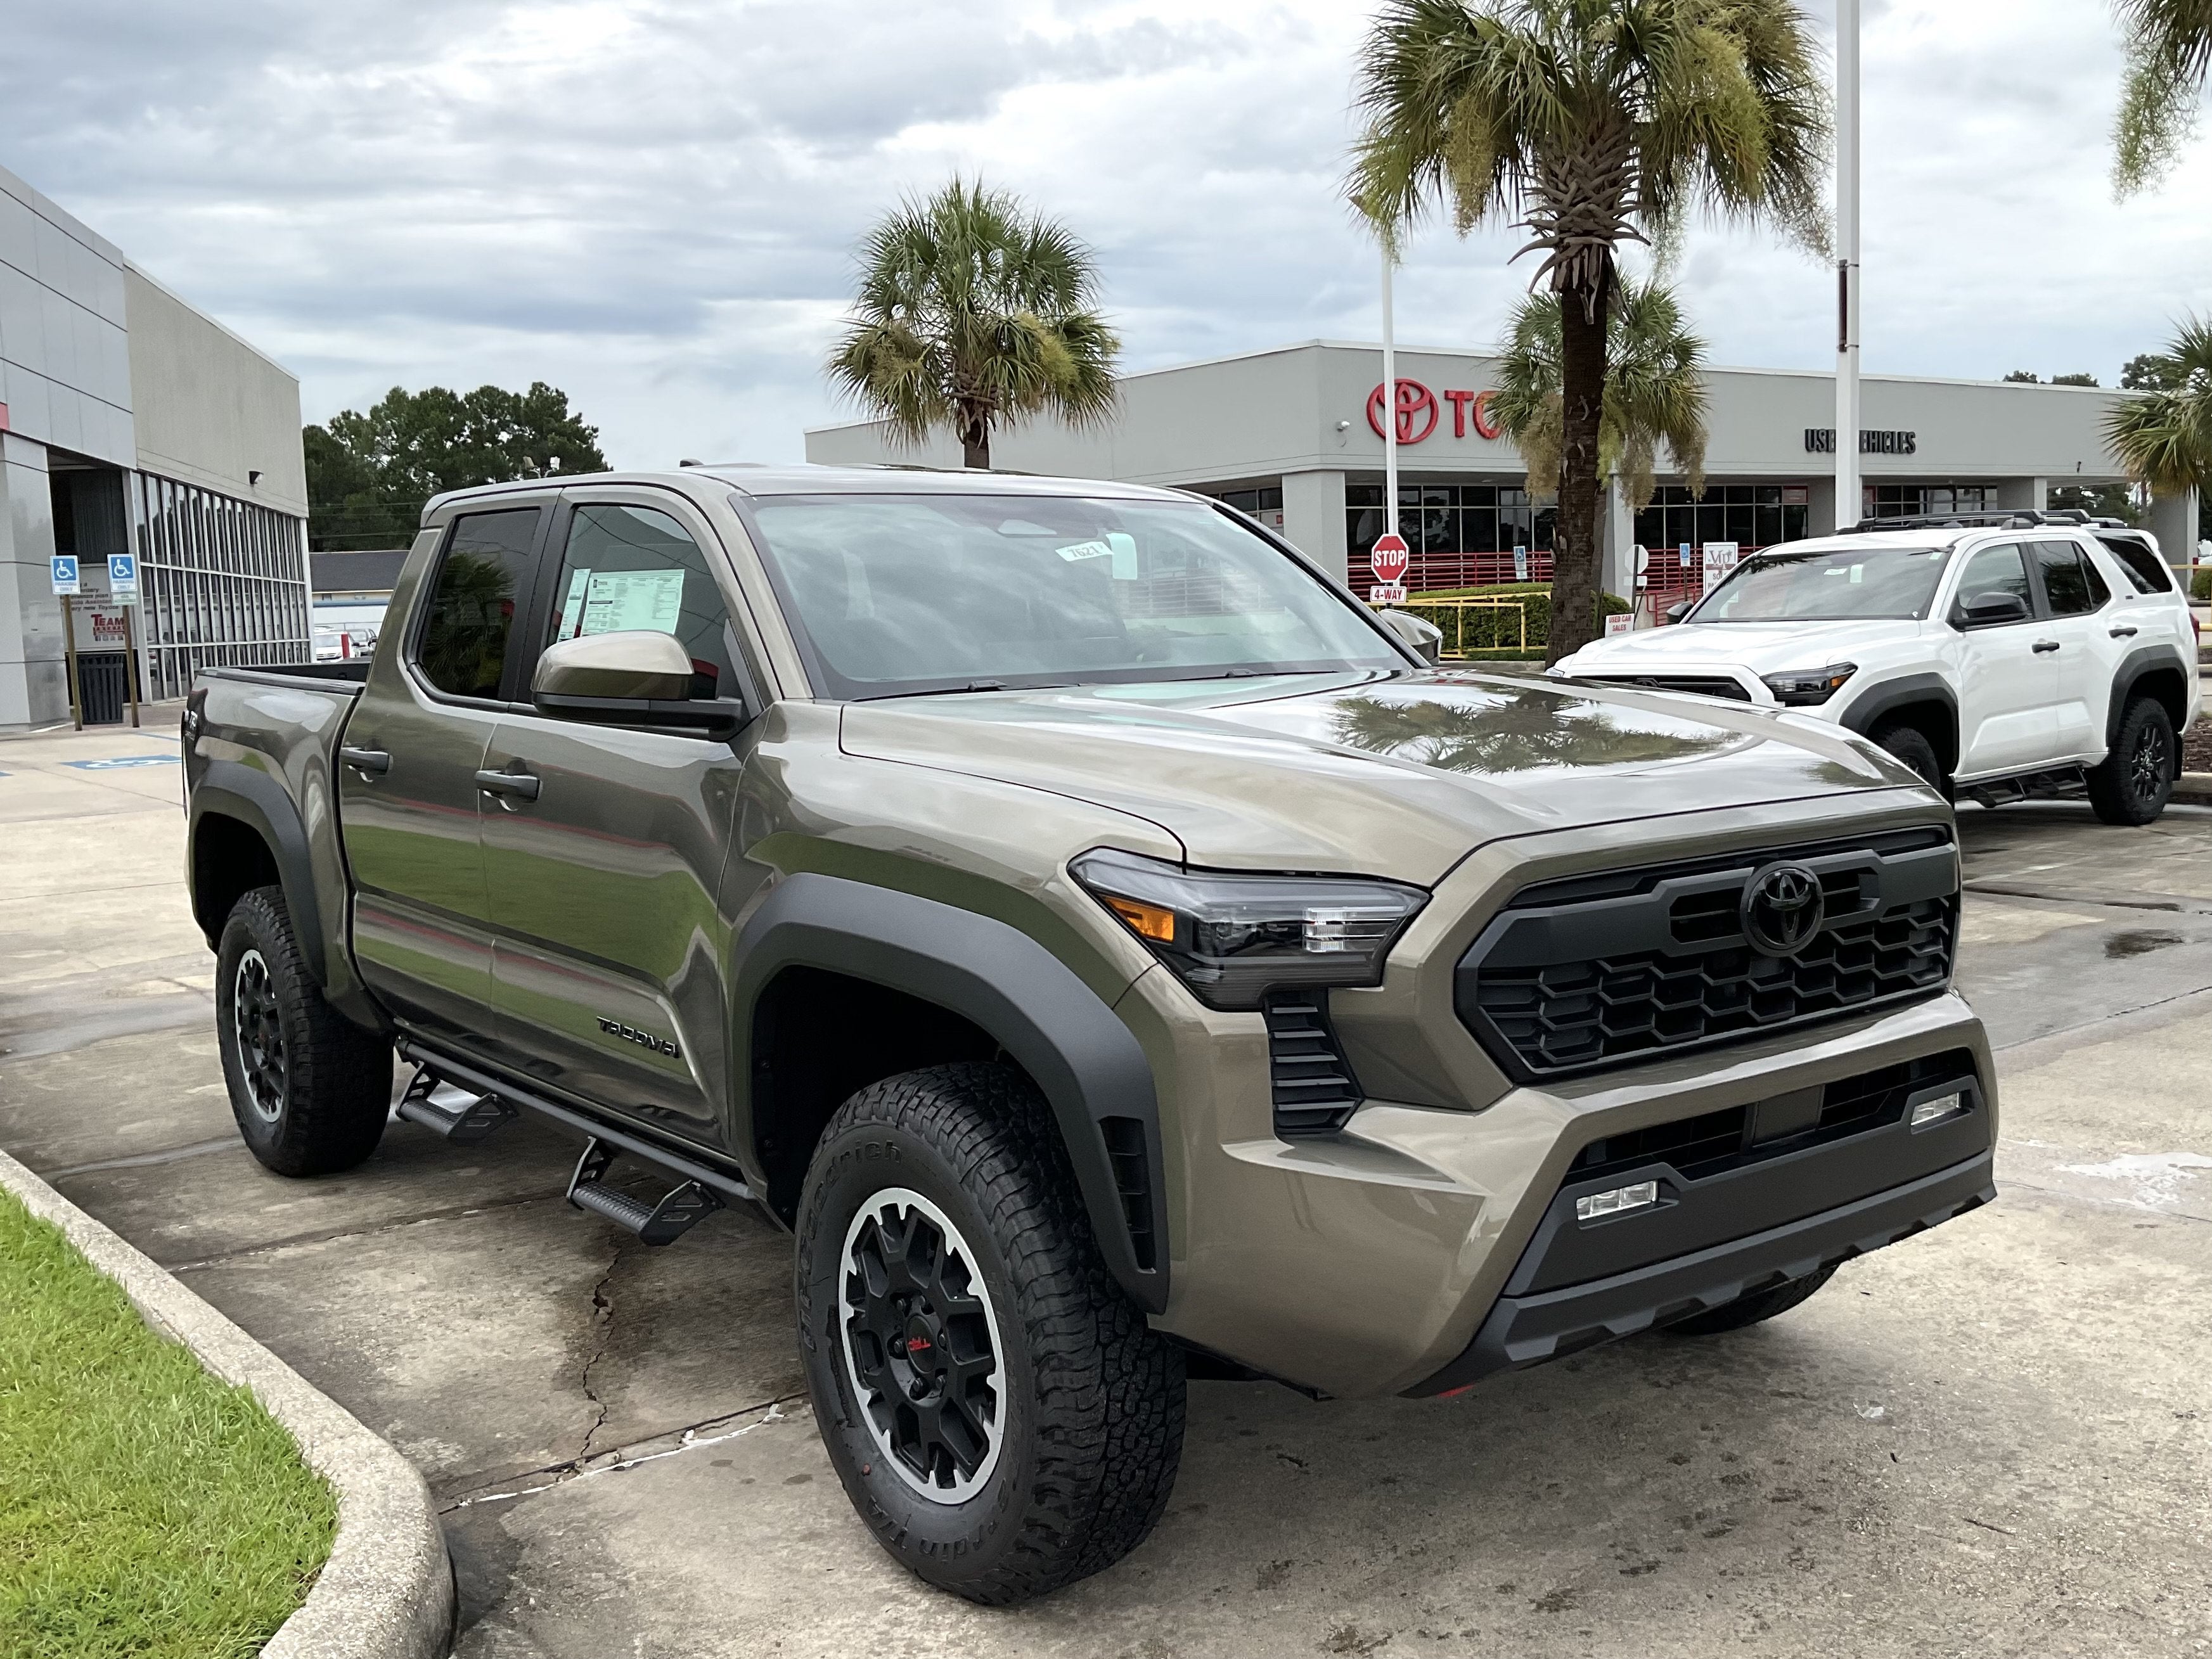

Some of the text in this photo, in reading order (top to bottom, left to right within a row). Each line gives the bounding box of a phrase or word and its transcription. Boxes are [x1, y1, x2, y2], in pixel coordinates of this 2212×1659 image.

[1804, 428, 1915, 454] USE EHICLES
[1374, 549, 1405, 567] STOP
[1374, 589, 1402, 600] 4-WAY
[596, 1016, 681, 1059] TACOMA
